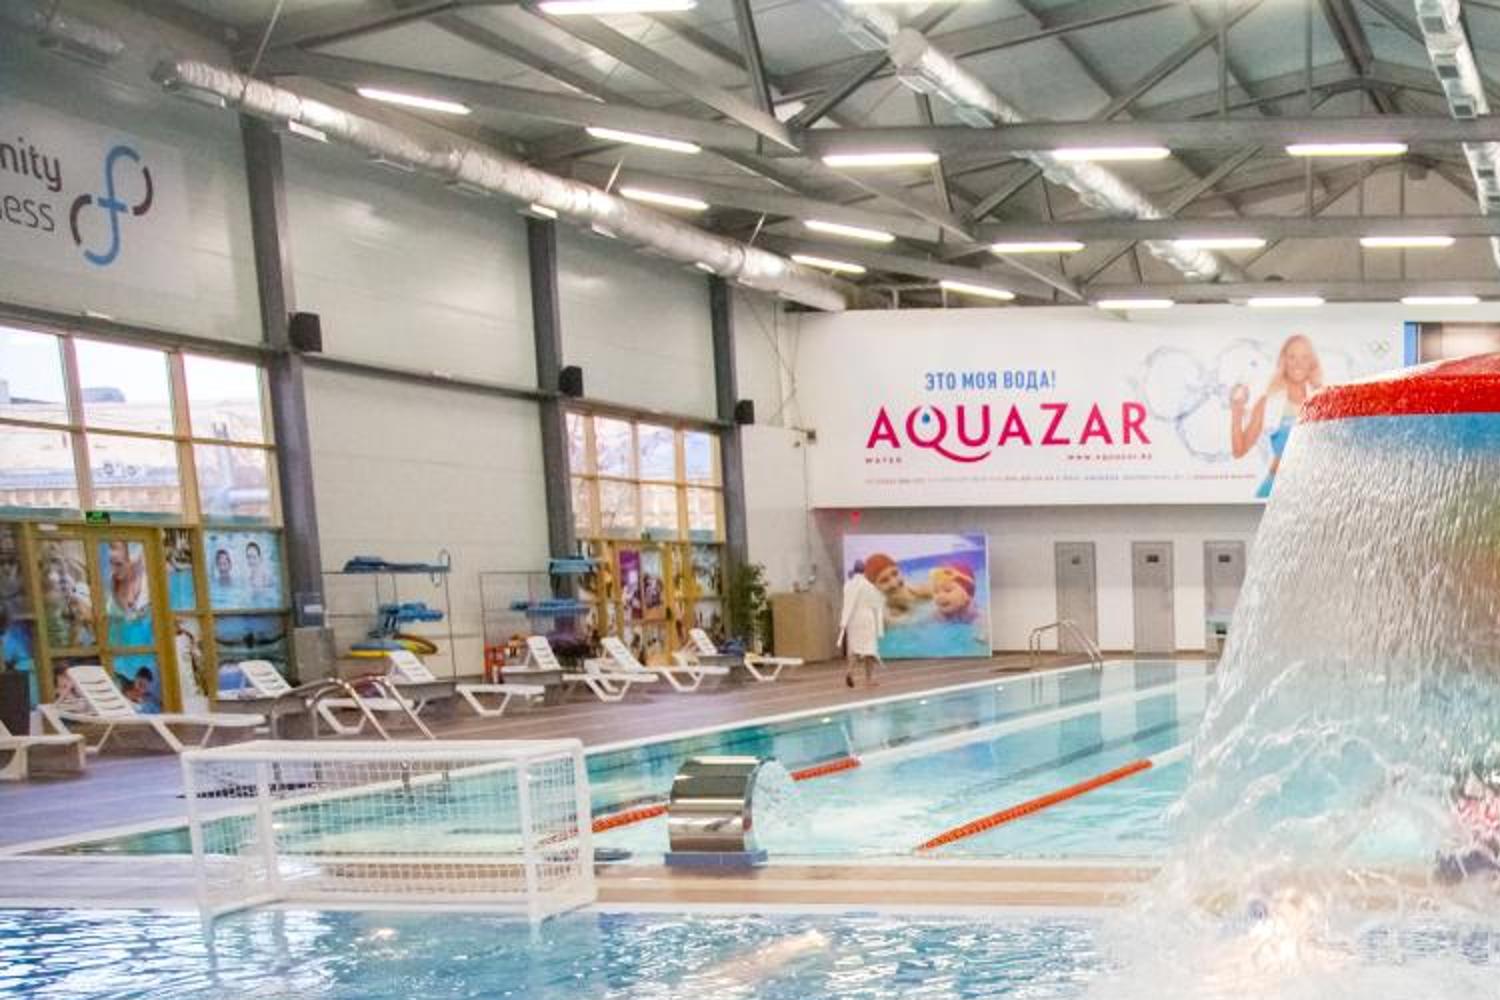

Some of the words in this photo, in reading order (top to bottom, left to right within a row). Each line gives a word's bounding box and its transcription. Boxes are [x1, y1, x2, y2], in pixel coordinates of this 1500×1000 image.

[0, 195, 56, 232] ess
[925, 371, 956, 391] ЭТО
[961, 371, 997, 390] МОЯ
[1003, 369, 1056, 391] ВОДА!
[866, 401, 1151, 462] AQUAZAR
